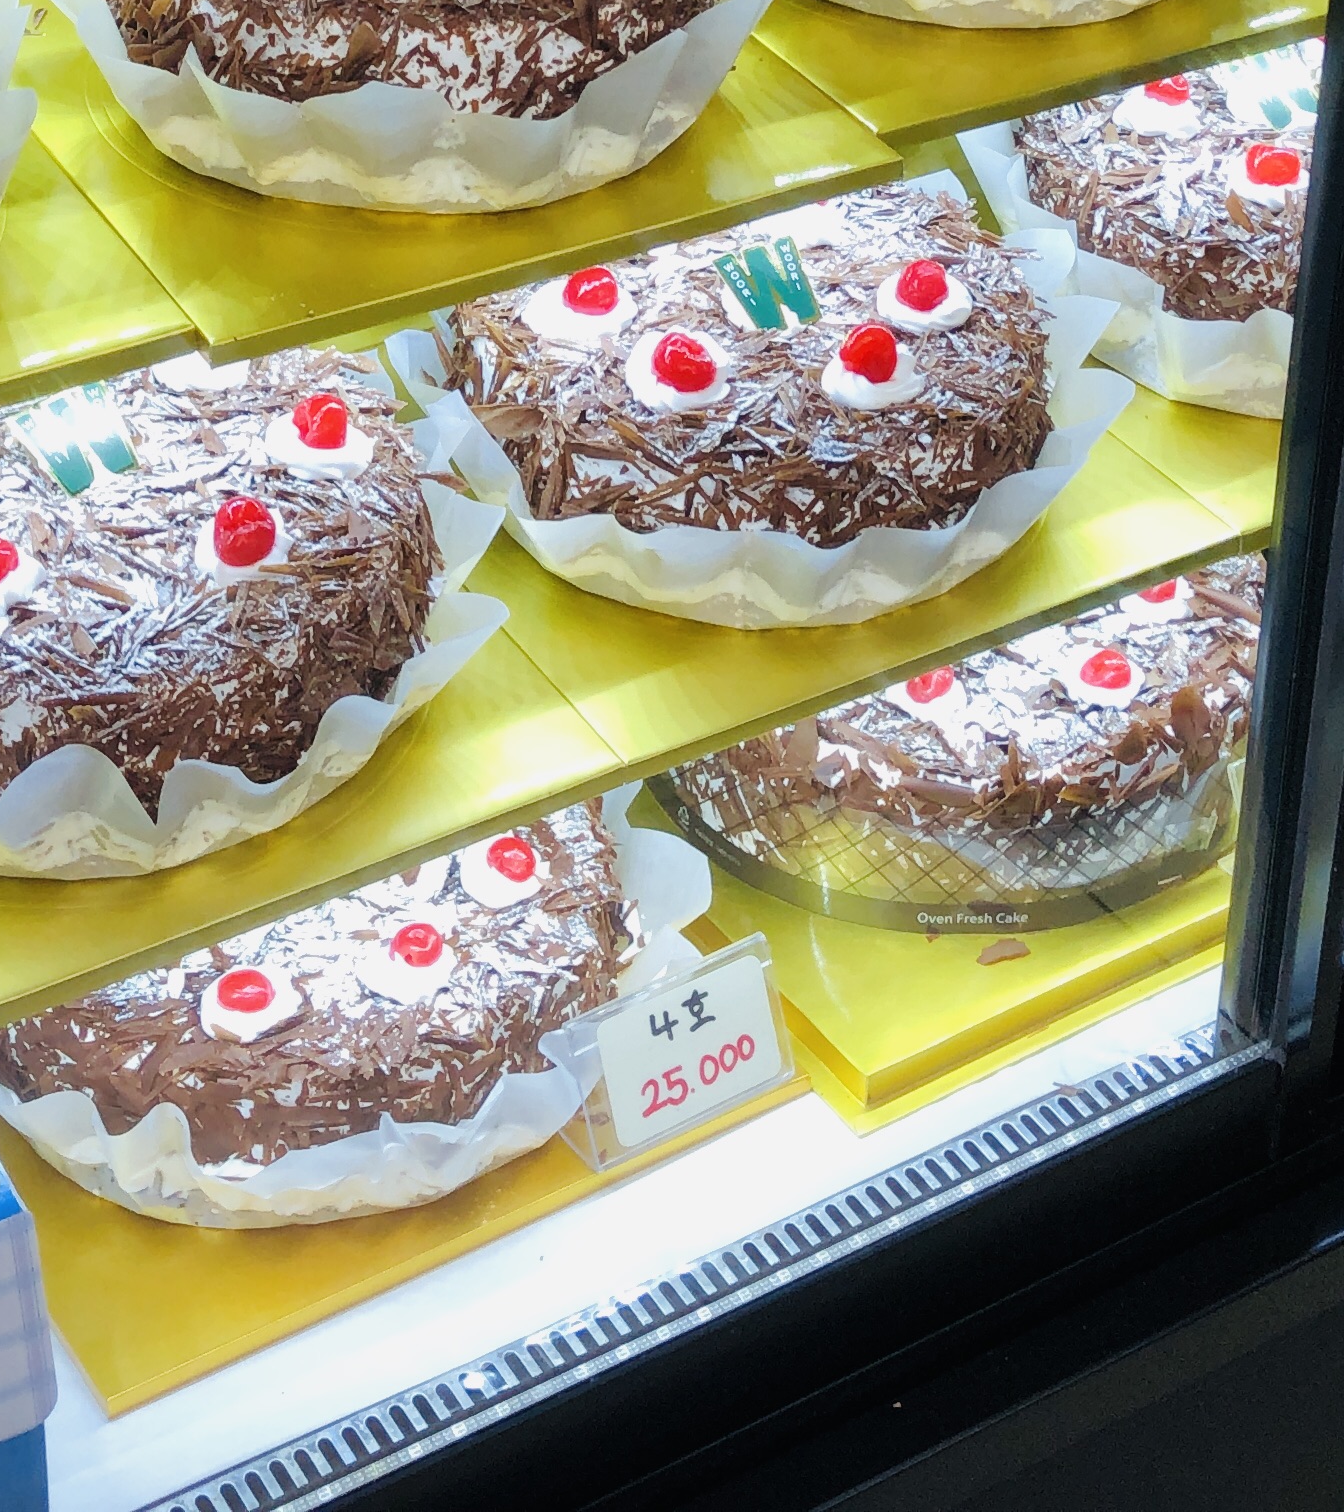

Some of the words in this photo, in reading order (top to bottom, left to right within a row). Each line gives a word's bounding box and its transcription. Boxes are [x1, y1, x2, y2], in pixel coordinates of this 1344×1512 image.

[917, 911, 953, 925] Oven
[957, 910, 993, 925] Fresh
[996, 910, 1029, 925] Cake
[648, 989, 716, 1043] 4호
[641, 1032, 757, 1119] 25.000
